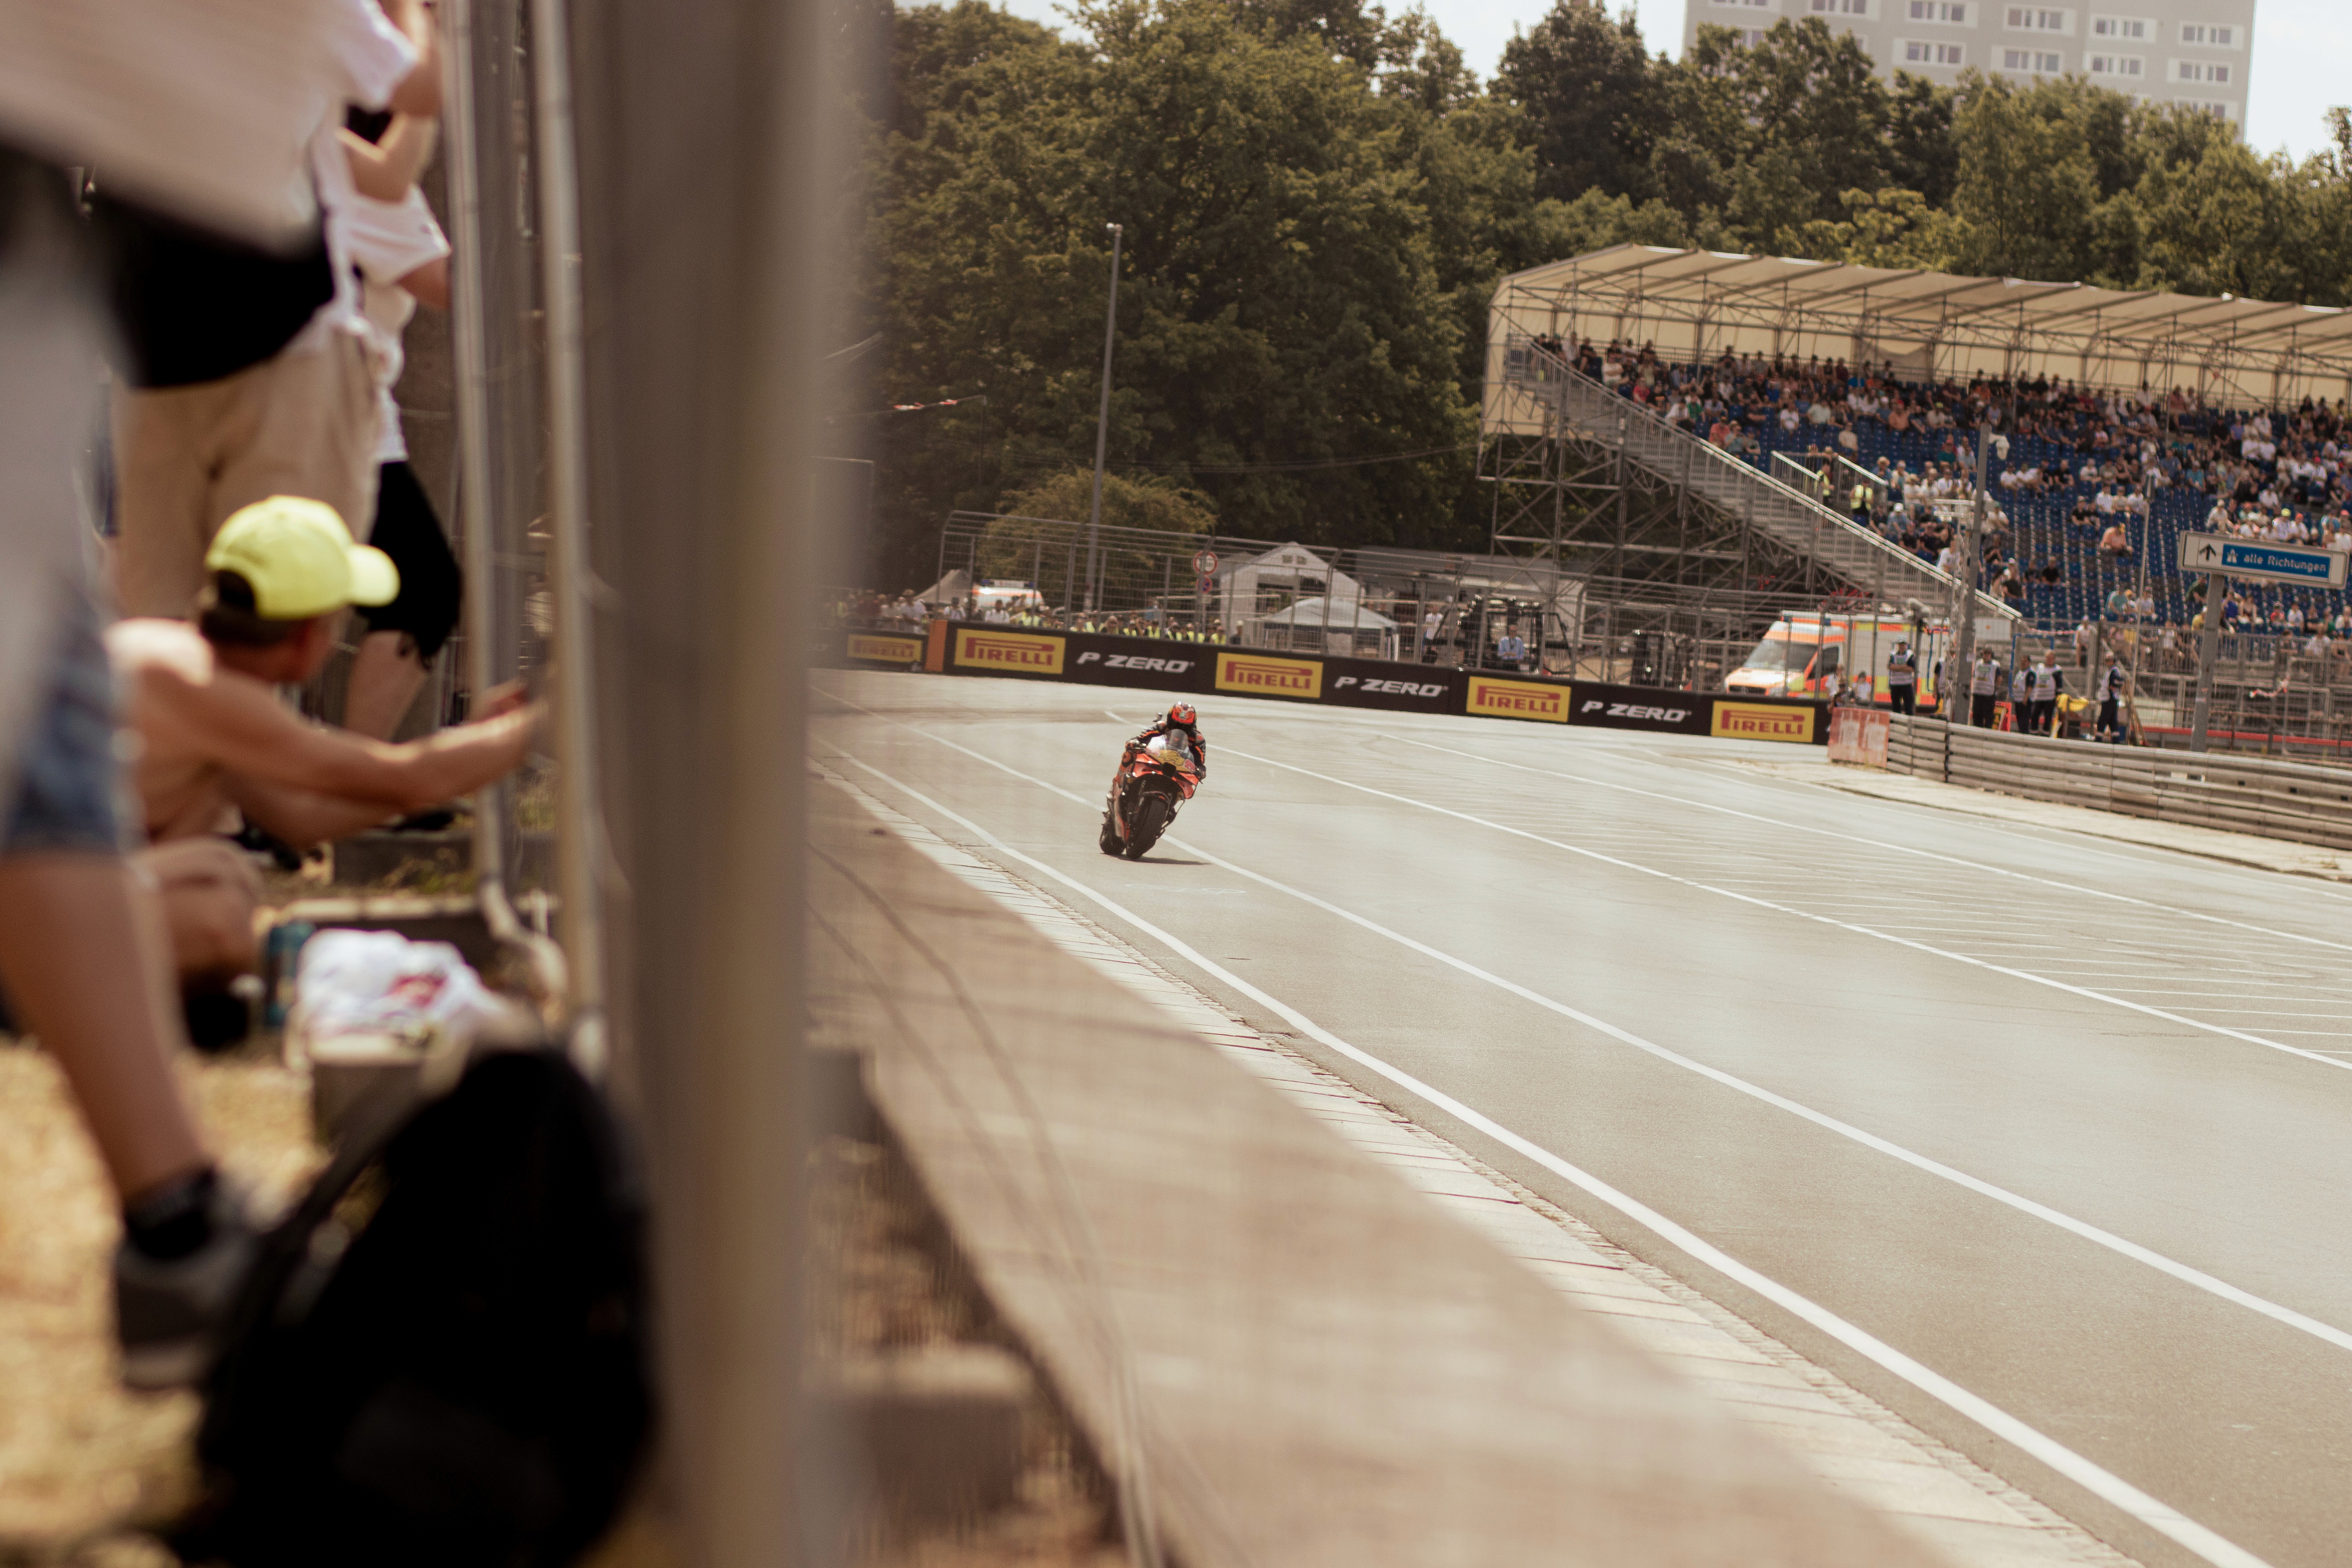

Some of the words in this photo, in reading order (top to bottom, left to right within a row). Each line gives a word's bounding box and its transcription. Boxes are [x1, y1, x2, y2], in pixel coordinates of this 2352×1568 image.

[2244, 554, 2263, 564] alle
[2268, 555, 2326, 573] Richtungen
[964, 637, 1055, 666] PIRELLI
[1077, 652, 1100, 664] P
[1225, 661, 1312, 689] PIRELLI
[1334, 677, 1357, 688] P
[1476, 686, 1561, 714] PIRELLI
[1581, 701, 1604, 713] P
[1721, 710, 1805, 735] PIRELLI
